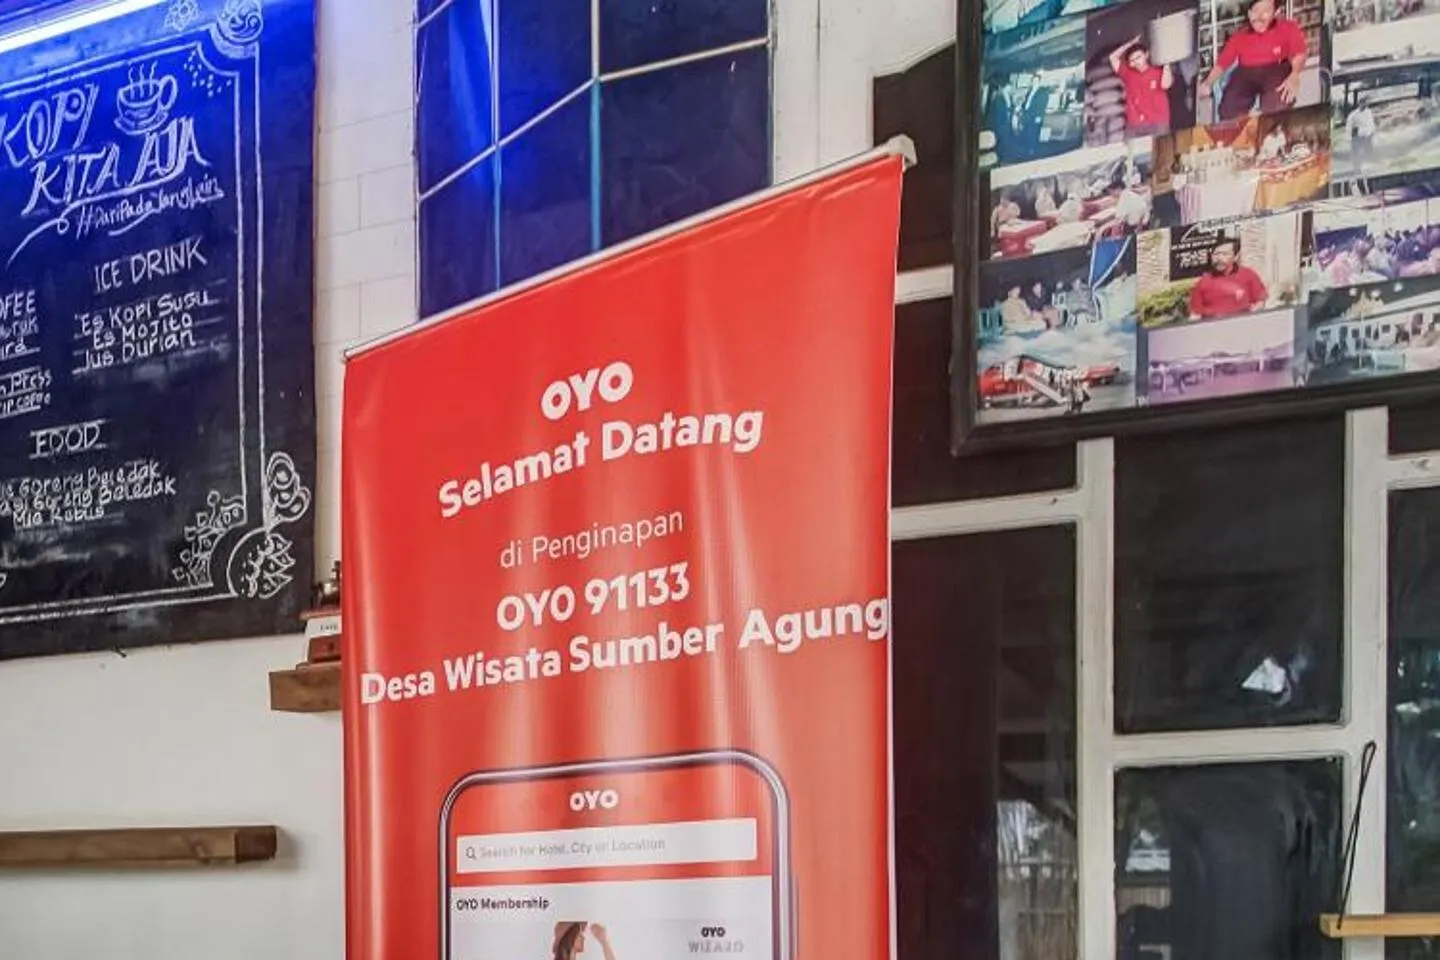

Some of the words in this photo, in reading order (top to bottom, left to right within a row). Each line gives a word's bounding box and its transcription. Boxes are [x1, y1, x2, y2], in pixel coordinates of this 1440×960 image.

[22, 142, 121, 216] KITA
[128, 116, 211, 187] AJA
[94, 260, 123, 293] ICE
[130, 235, 207, 284] DRINK
[540, 361, 633, 420] OYO
[33, 423, 100, 456] FOOD
[439, 432, 590, 517] Selamat
[601, 409, 764, 461] Datang
[500, 539, 523, 569] di
[532, 508, 684, 563] Penginapan
[497, 583, 576, 630] OYO
[584, 561, 690, 616] 91133
[361, 664, 435, 704] Desa
[443, 649, 561, 693] Wisata
[568, 620, 724, 672] Sumber
[737, 597, 890, 655] Agung
[570, 789, 619, 811] OYO
[457, 899, 478, 911] OYO
[481, 896, 550, 911] Membership
[701, 926, 726, 938] OYO
